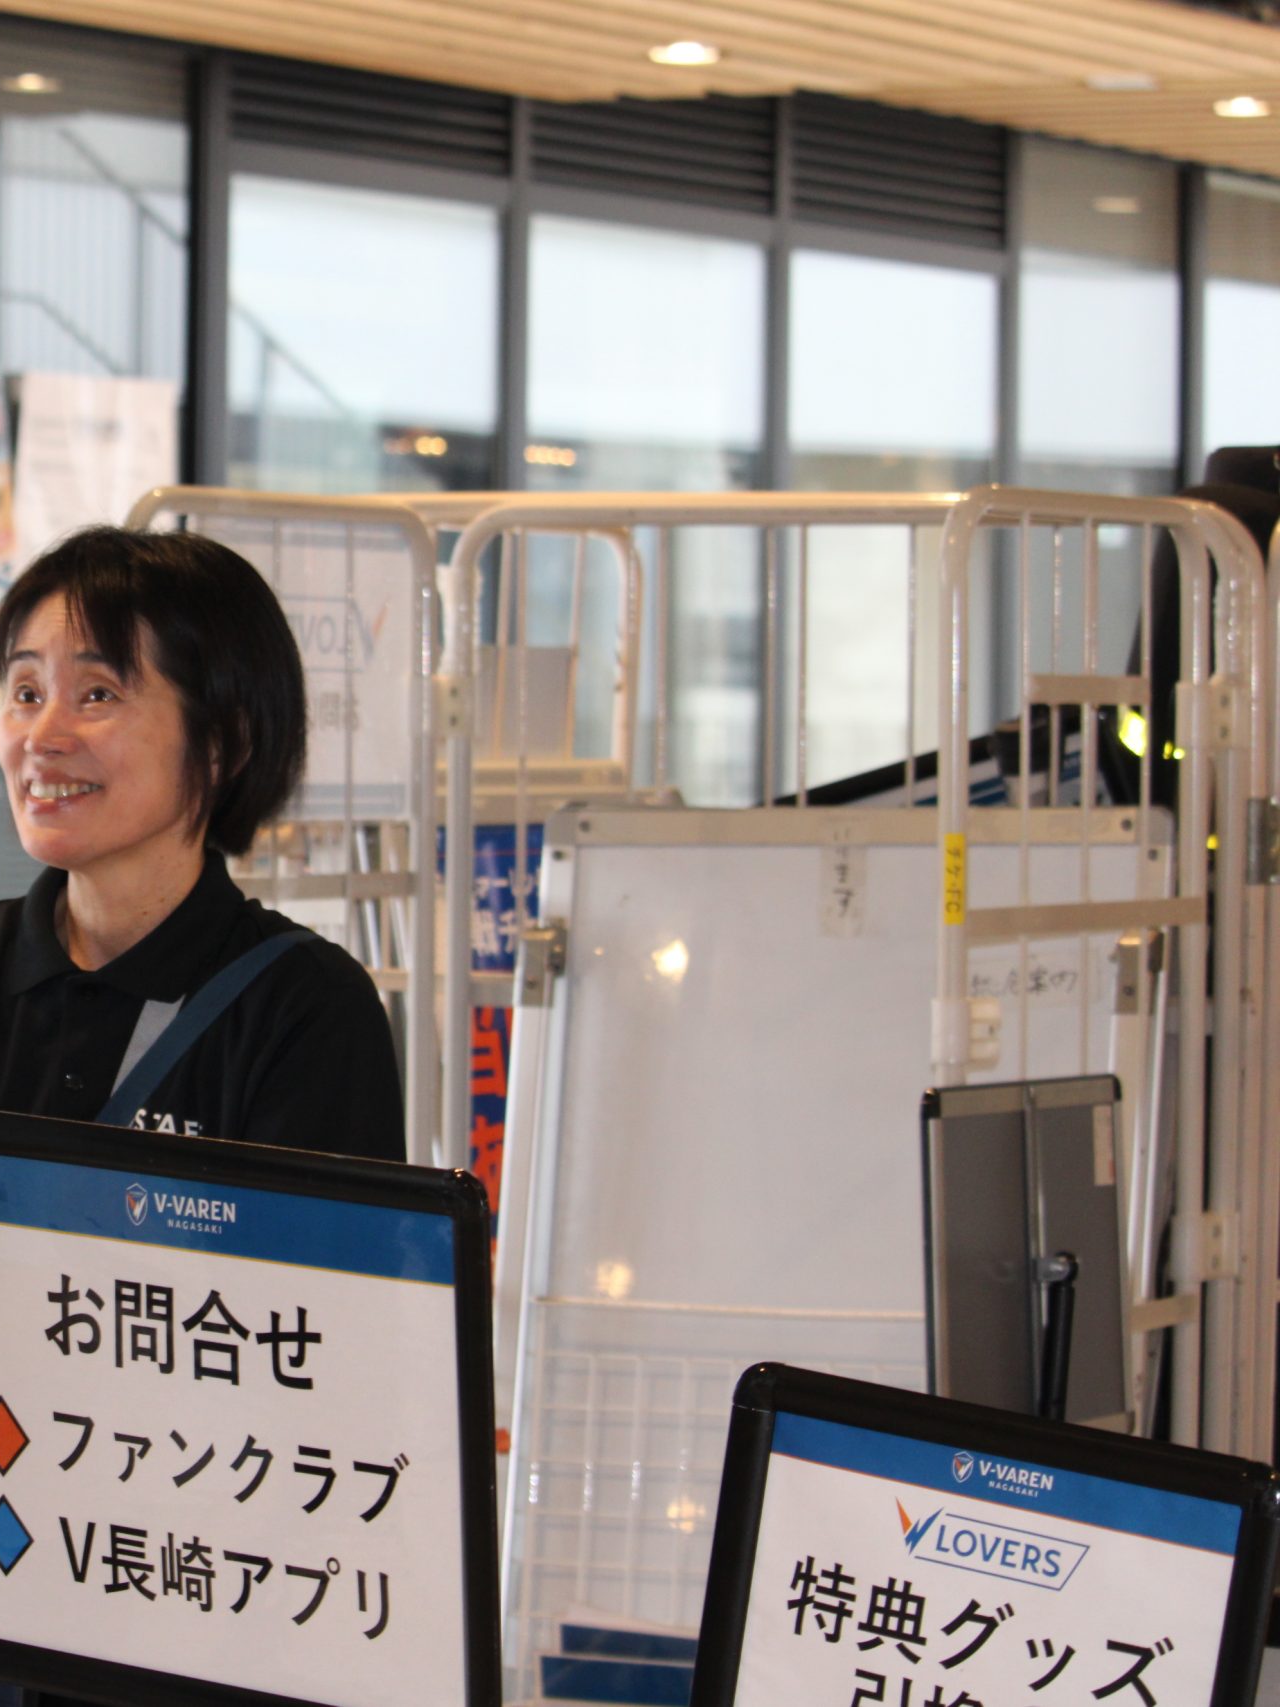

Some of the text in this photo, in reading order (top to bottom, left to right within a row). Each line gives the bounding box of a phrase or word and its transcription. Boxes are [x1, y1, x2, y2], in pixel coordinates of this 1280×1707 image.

[153, 1192, 237, 1223] V-VAREN
[167, 1218, 223, 1235] NAGASAKI
[44, 1273, 322, 1390] お問合せ
[52, 1411, 410, 1523] ファンクラブ
[979, 1459, 1054, 1491] V-VAREN
[988, 1481, 1039, 1498] NAGASAKI
[935, 1524, 1062, 1578] LOVERS
[58, 1516, 390, 1641] V長崎アプリ
[786, 1554, 1175, 1707] 特典グッズ
